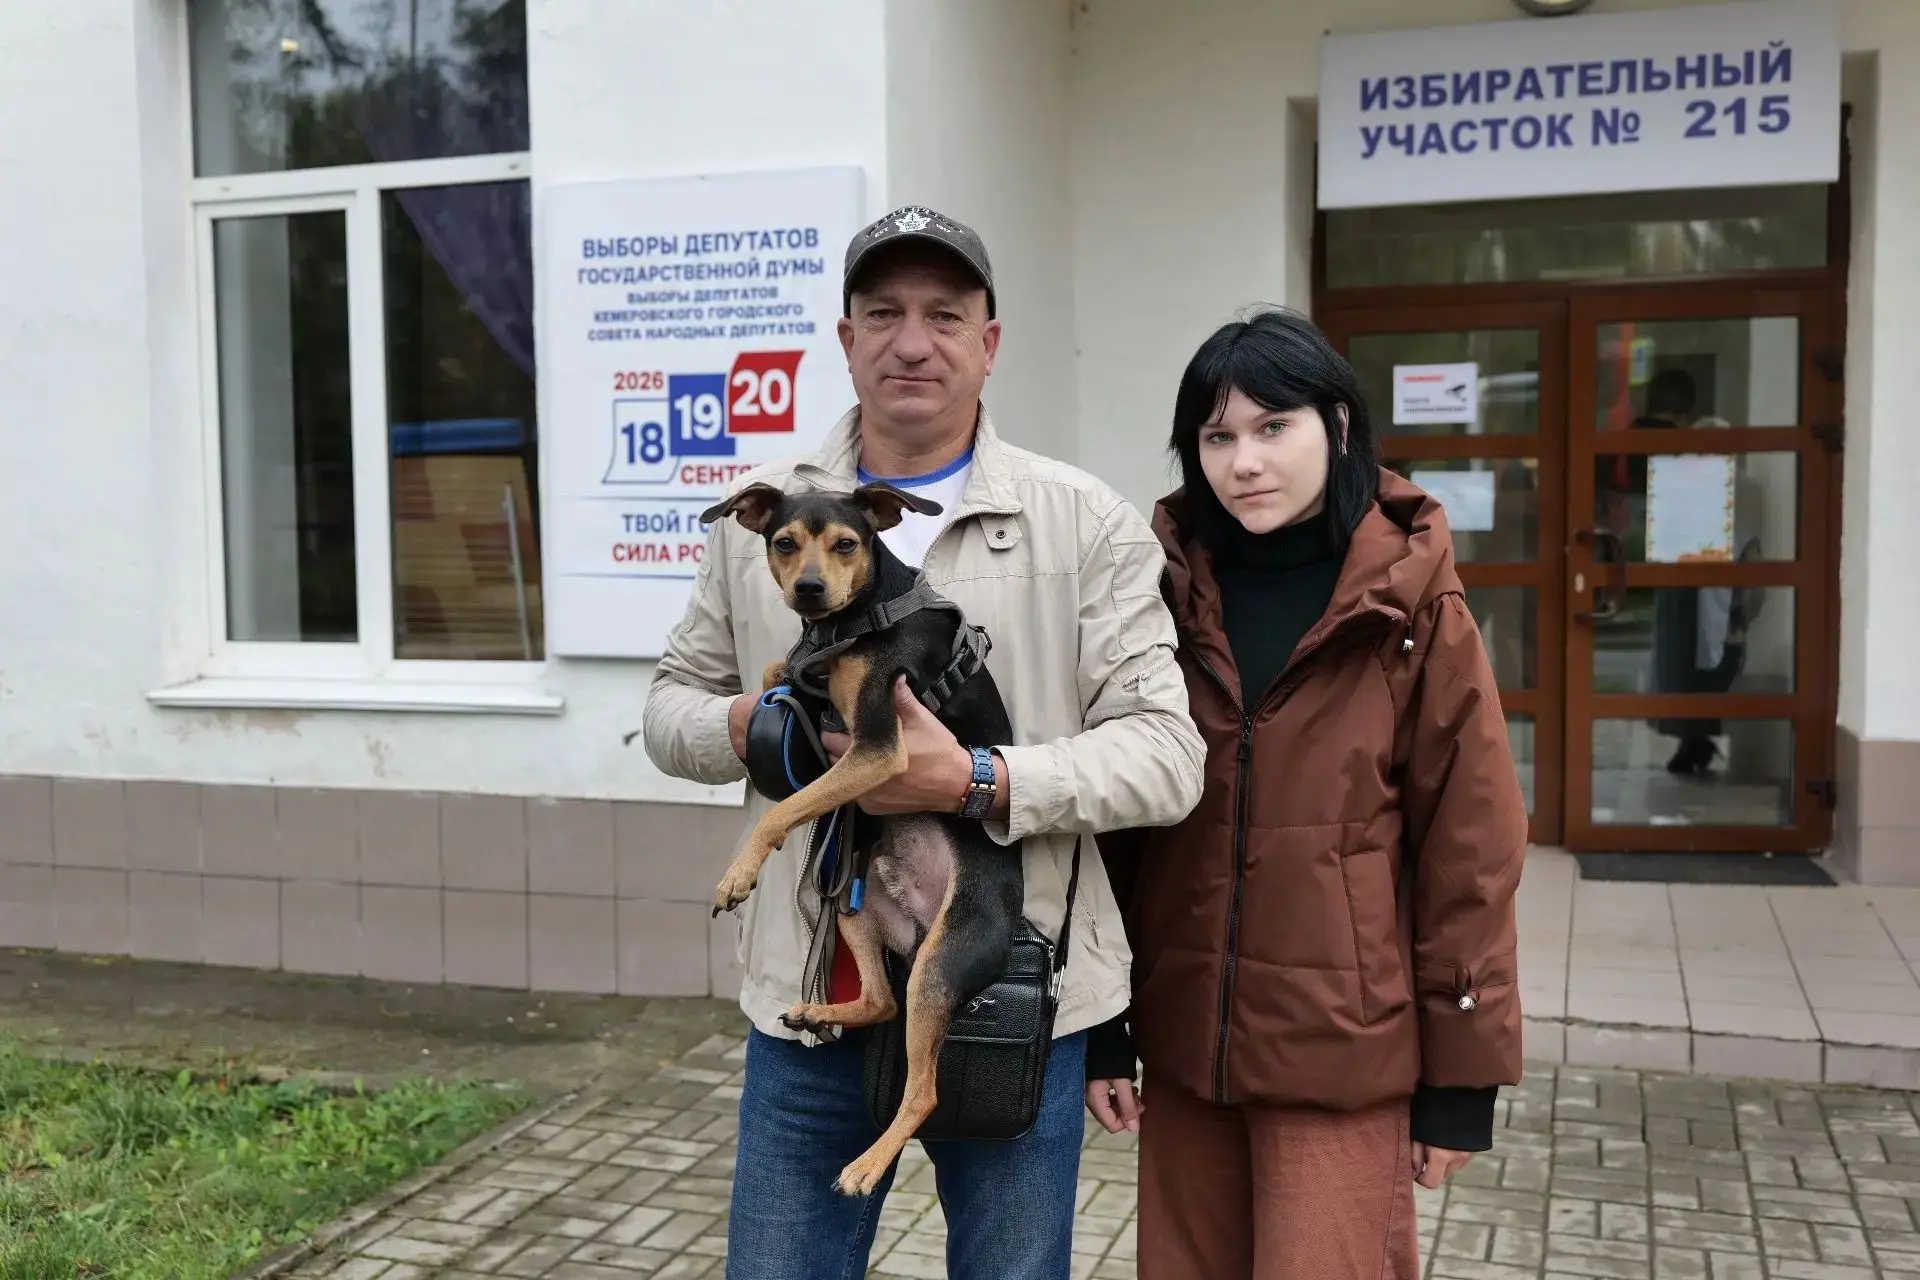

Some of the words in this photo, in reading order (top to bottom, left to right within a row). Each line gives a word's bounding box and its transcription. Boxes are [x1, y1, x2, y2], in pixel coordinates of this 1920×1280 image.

[1360, 41, 1792, 112] ИЗБИРАТЕЛЬНЫЙ
[1360, 114, 1573, 159] УЧАСТОК
[1591, 108, 1641, 145] №
[1684, 96, 1791, 138] 215
[583, 235, 678, 259] ВЫБОРЫ
[684, 228, 819, 257] ДЕПУТАТОВ
[578, 258, 761, 285] ГОСУДАРСТВЕННОЙ
[765, 257, 825, 279] ДУМЫ
[627, 290, 690, 304] ВЫБОРЫ
[693, 286, 779, 303] ДЕПУТАТОВ
[593, 307, 704, 323] КЕМЕРОВСКОГО
[708, 304, 804, 319] ГОРОДСКОГО
[587, 328, 642, 342] СОВЕТА
[645, 324, 727, 340] НАРОДНЫХ
[730, 321, 816, 339] ДЕПУТАТОВ
[613, 371, 664, 391] 2026
[731, 368, 792, 417] 20
[674, 393, 722, 441] 19
[621, 422, 665, 465] 18
[680, 464, 757, 484] СЕНТ
[622, 509, 680, 534] ТВОЙ
[612, 543, 670, 563] СИЛА
